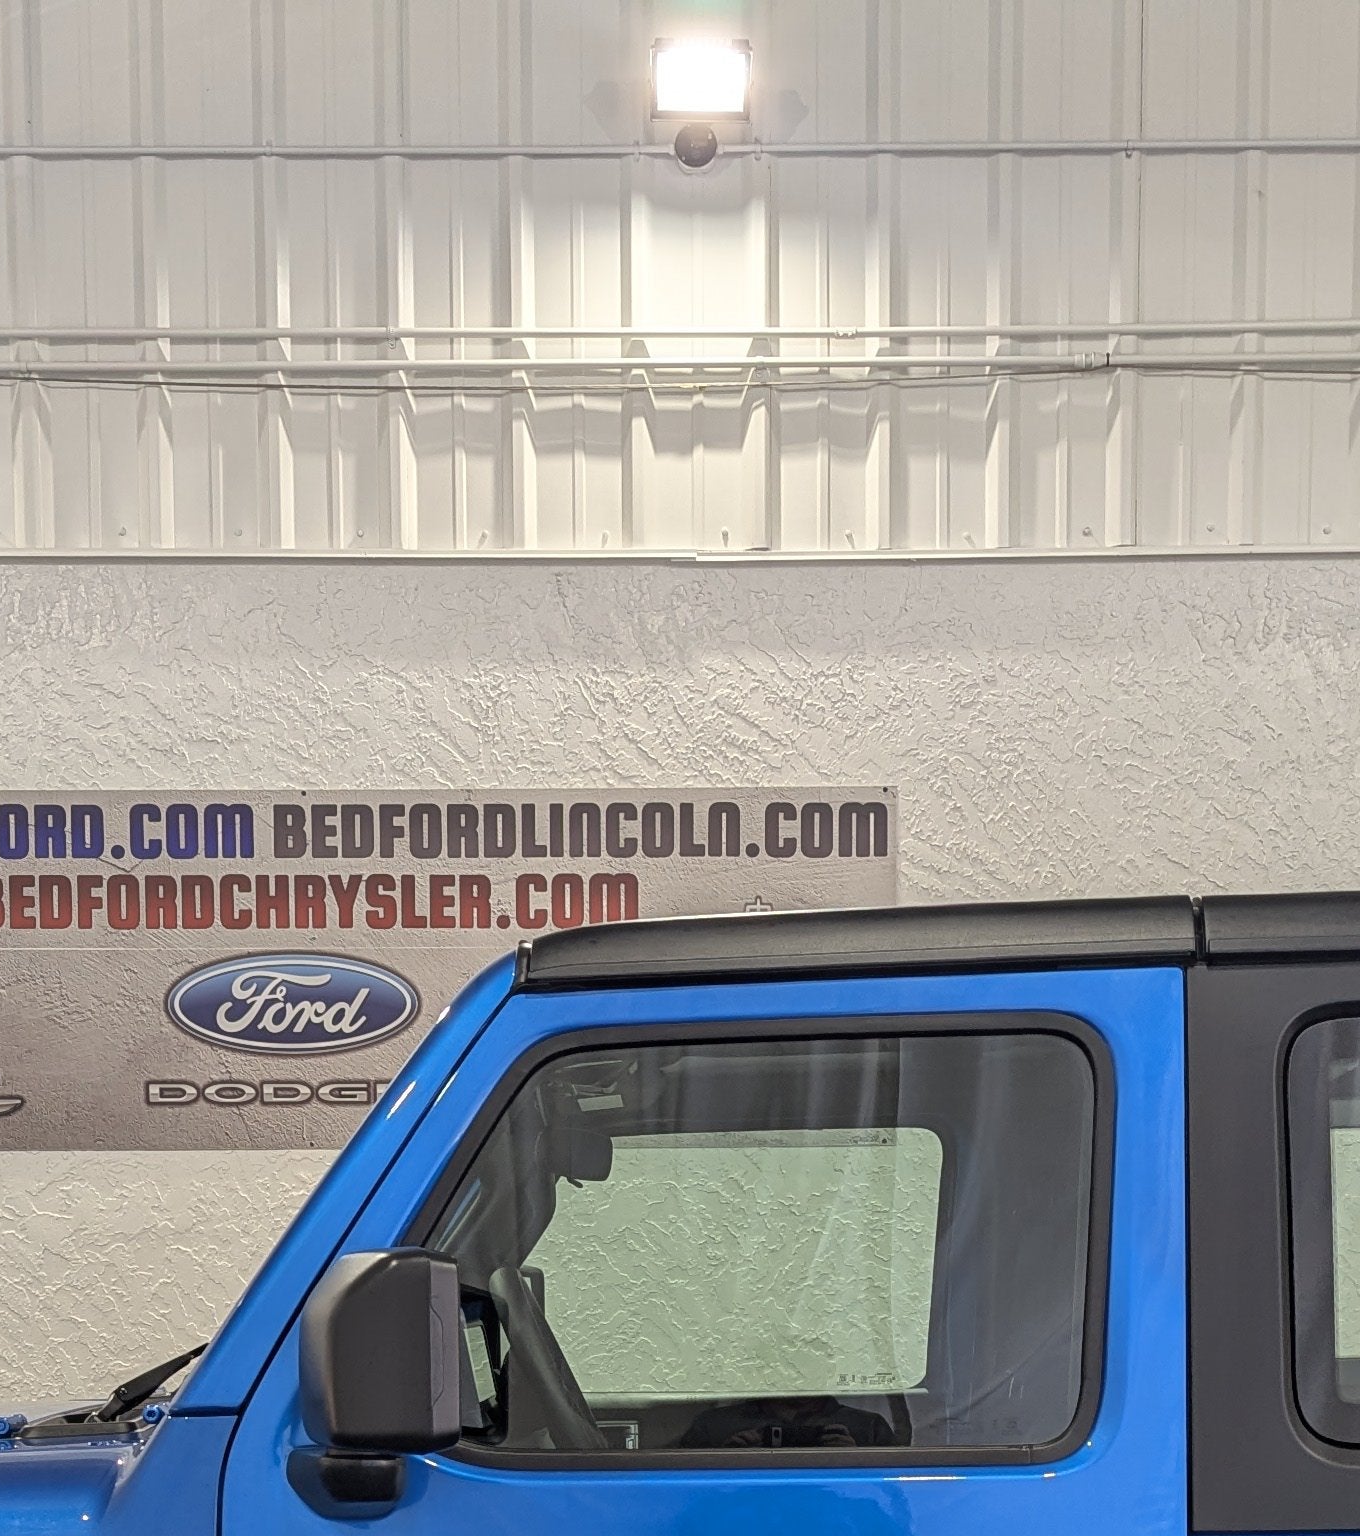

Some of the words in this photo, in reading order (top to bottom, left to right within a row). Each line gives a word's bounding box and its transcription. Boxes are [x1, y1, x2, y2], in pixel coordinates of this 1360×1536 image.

[273, 802, 889, 859] BEDFORDLINCOLN.COM
[216, 970, 370, 1034] Ford
[146, 1081, 392, 1104] DODG
